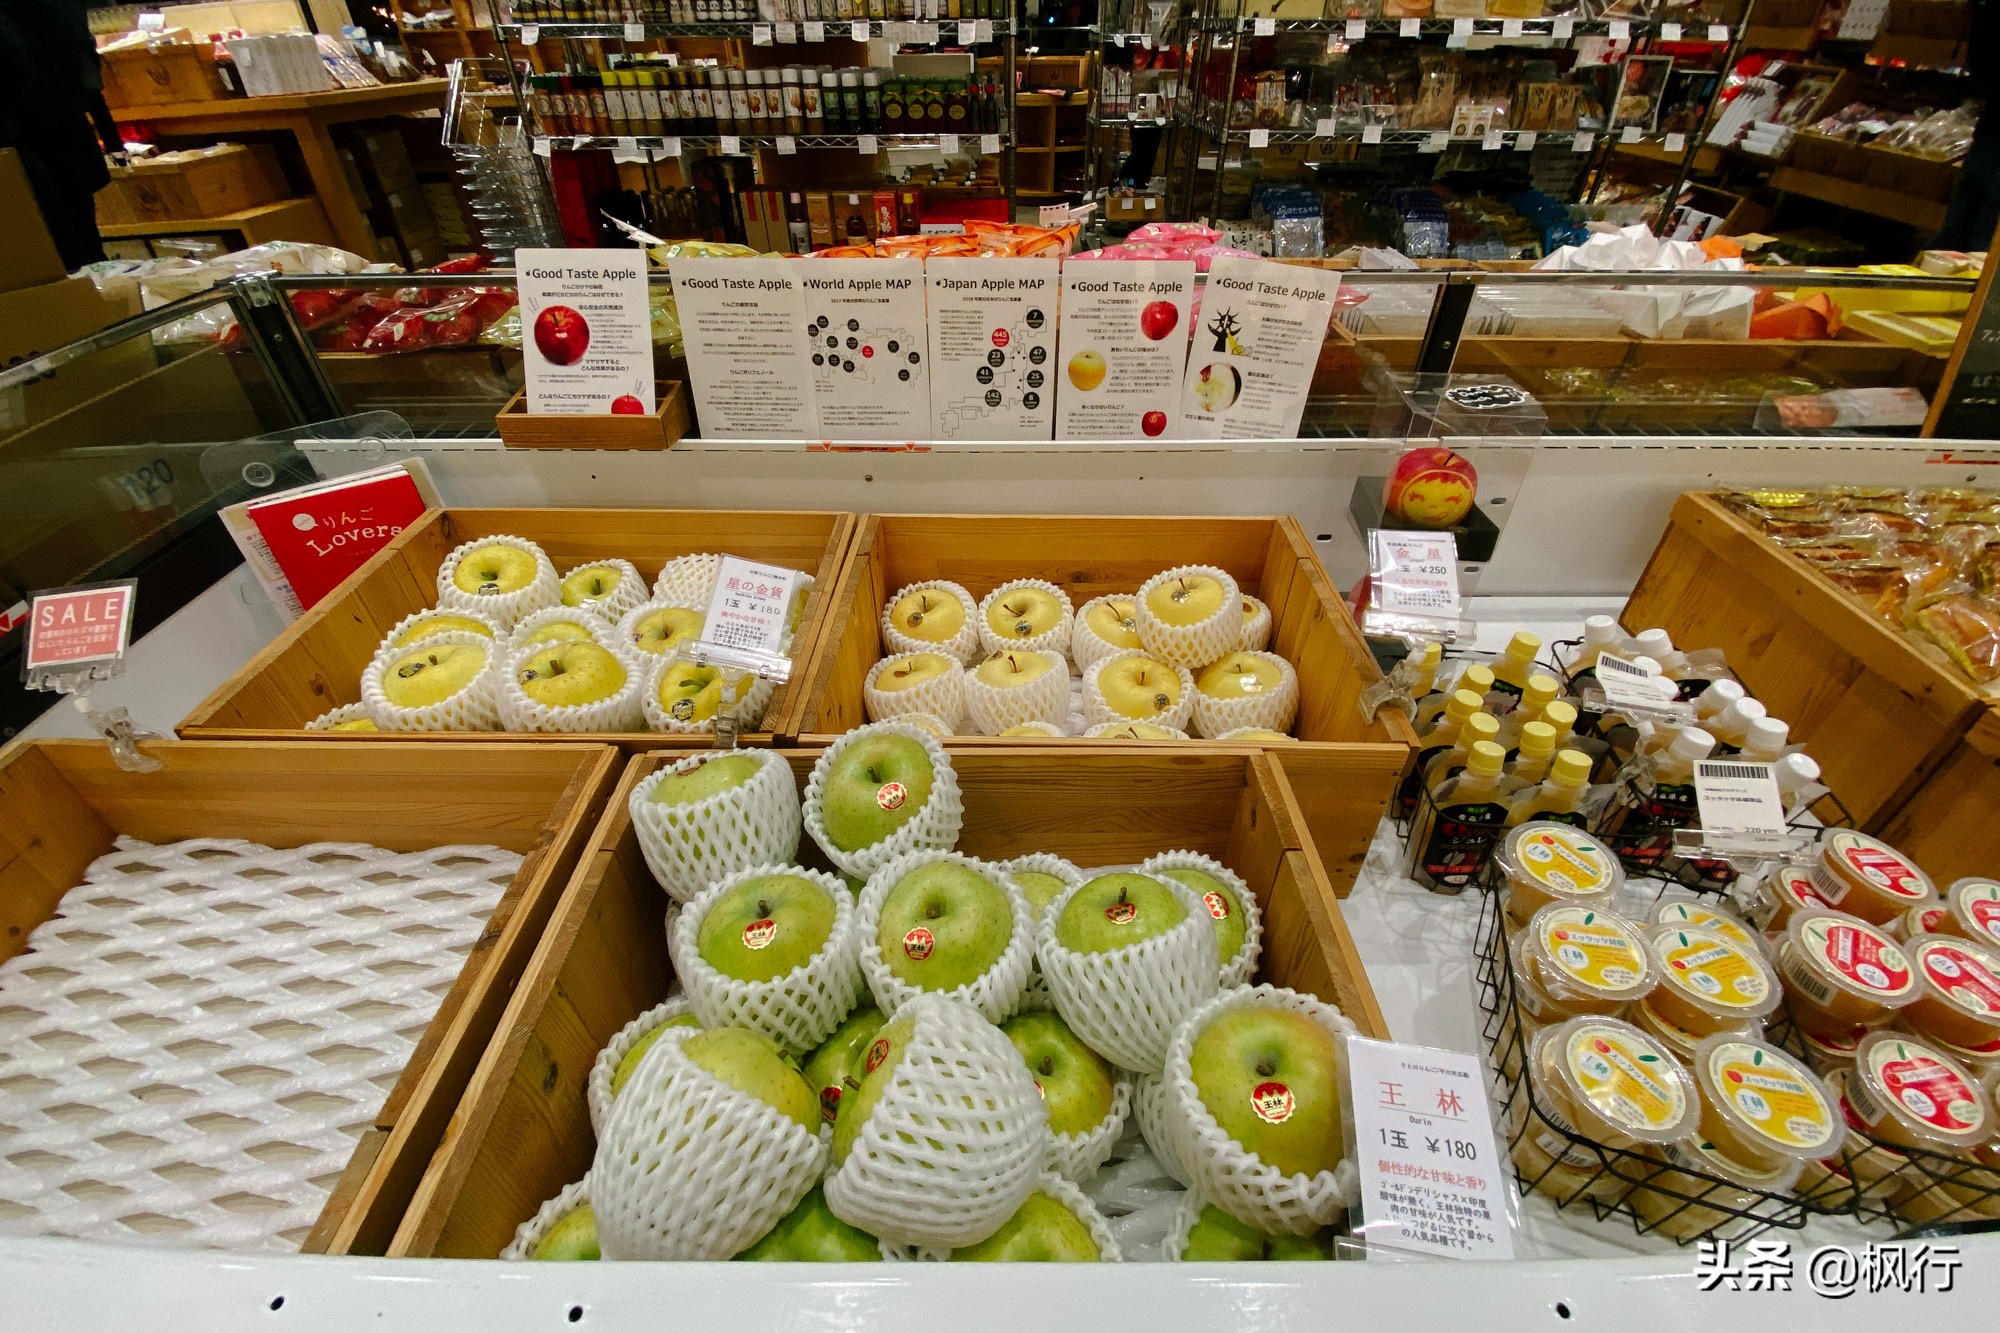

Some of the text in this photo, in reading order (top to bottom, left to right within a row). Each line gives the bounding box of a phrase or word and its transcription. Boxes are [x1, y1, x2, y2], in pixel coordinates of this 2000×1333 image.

[532, 268, 637, 281] Good Taste Apple
[688, 278, 792, 292] Good Taste Apple
[809, 279, 912, 291] World Apple MAP
[942, 279, 1045, 291] Japan Apple MAP
[1078, 281, 1183, 294] Good Taste Apple
[1222, 278, 1326, 302] Good Taste Apple
[323, 507, 374, 528] りんご
[306, 525, 403, 557] Lovers
[727, 577, 783, 599] 星の金貨
[41, 598, 119, 627] SALE
[725, 598, 741, 608] 1玉
[1263, 1097, 1284, 1110] 王林
[1379, 1080, 1465, 1117] 王 林
[1409, 1115, 1432, 1127] Ourin
[1379, 1127, 1477, 1161] 1玉 ¥180
[1377, 1158, 1487, 1192] 個性的な甘味と香り
[1379, 1190, 1492, 1221] 酸味が無く、王林独特の果
[1390, 1203, 1480, 1230] 肉の甘味が人気です。
[1401, 1228, 1473, 1251] の人気品種です。
